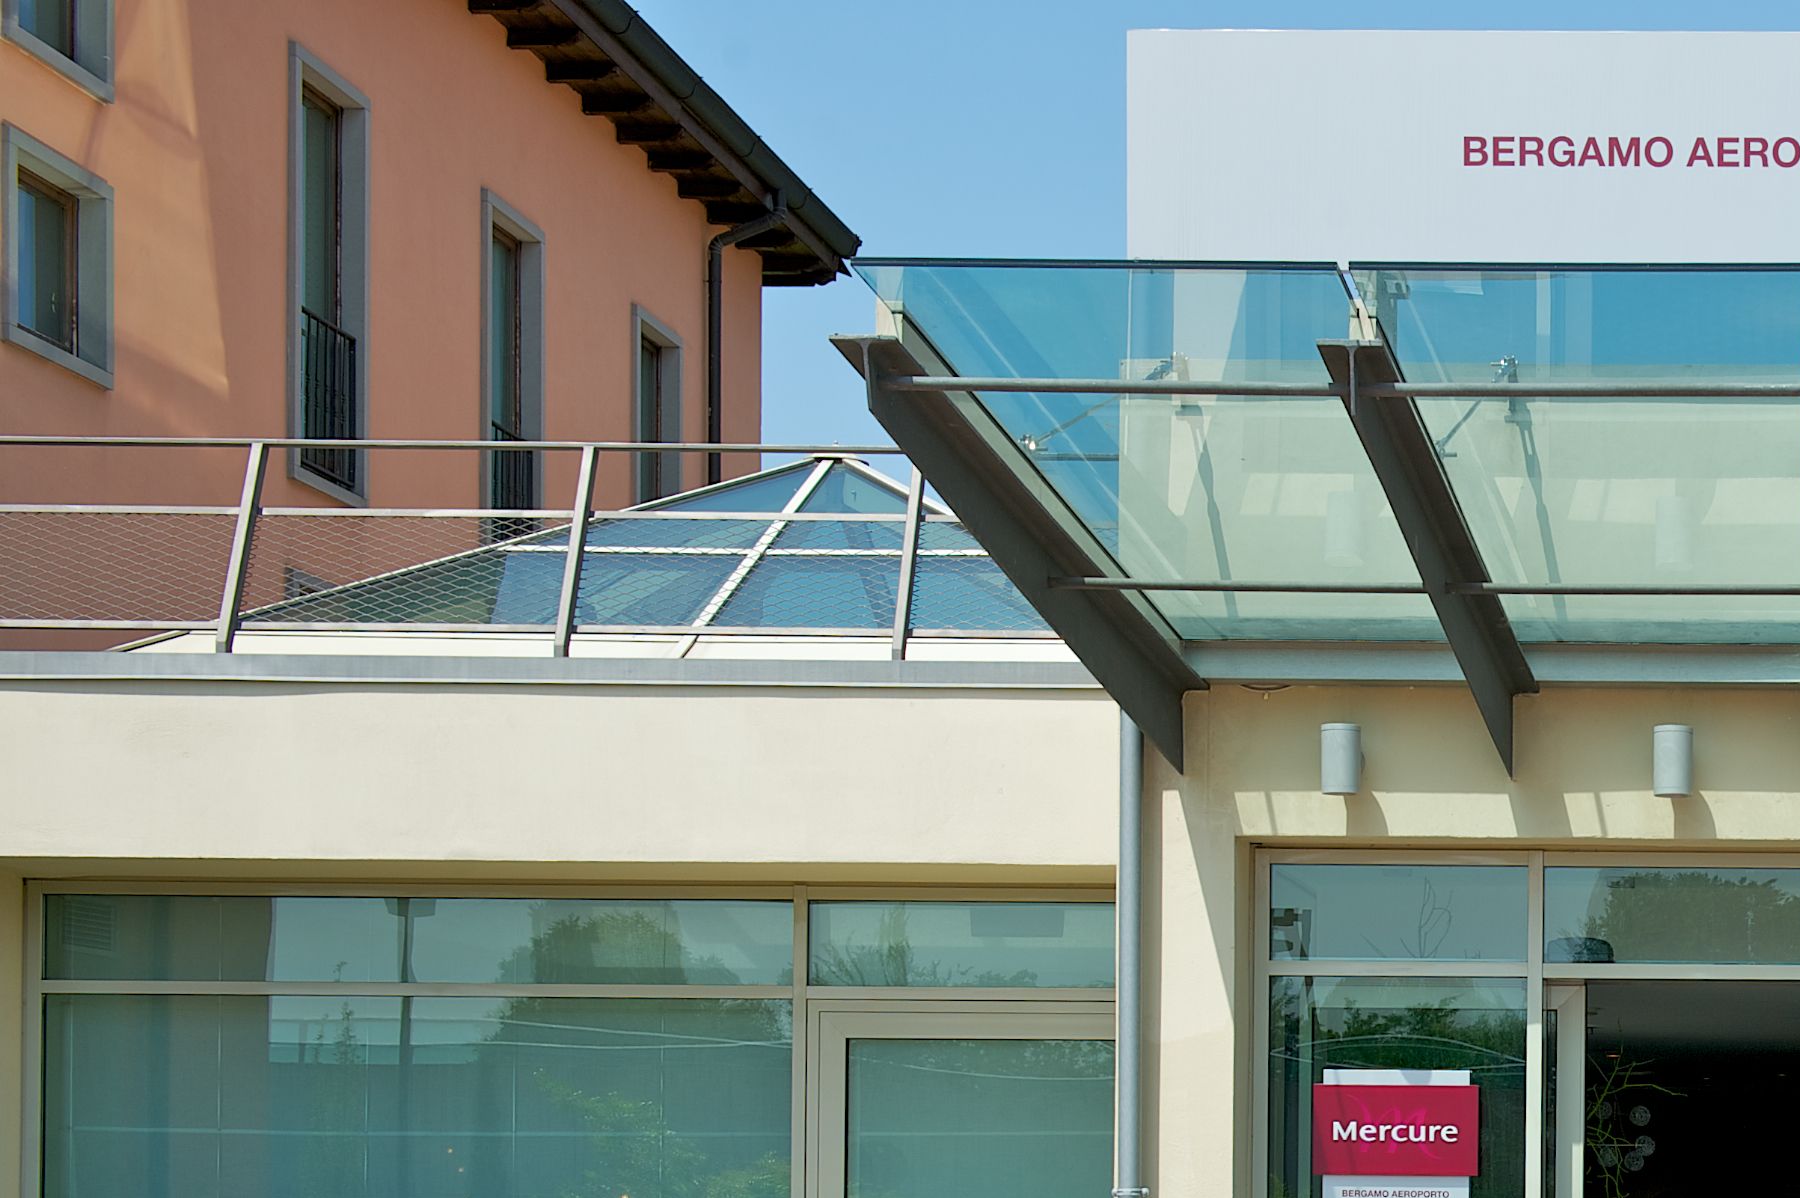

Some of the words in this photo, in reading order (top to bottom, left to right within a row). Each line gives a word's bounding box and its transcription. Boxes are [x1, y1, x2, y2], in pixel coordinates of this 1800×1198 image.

[1463, 136, 1674, 168] BERGAMO
[1332, 1120, 1459, 1143] Mercure
[1341, 1189, 1389, 1198] BERGAMO
[1391, 1189, 1450, 1198] AEROPORTO
